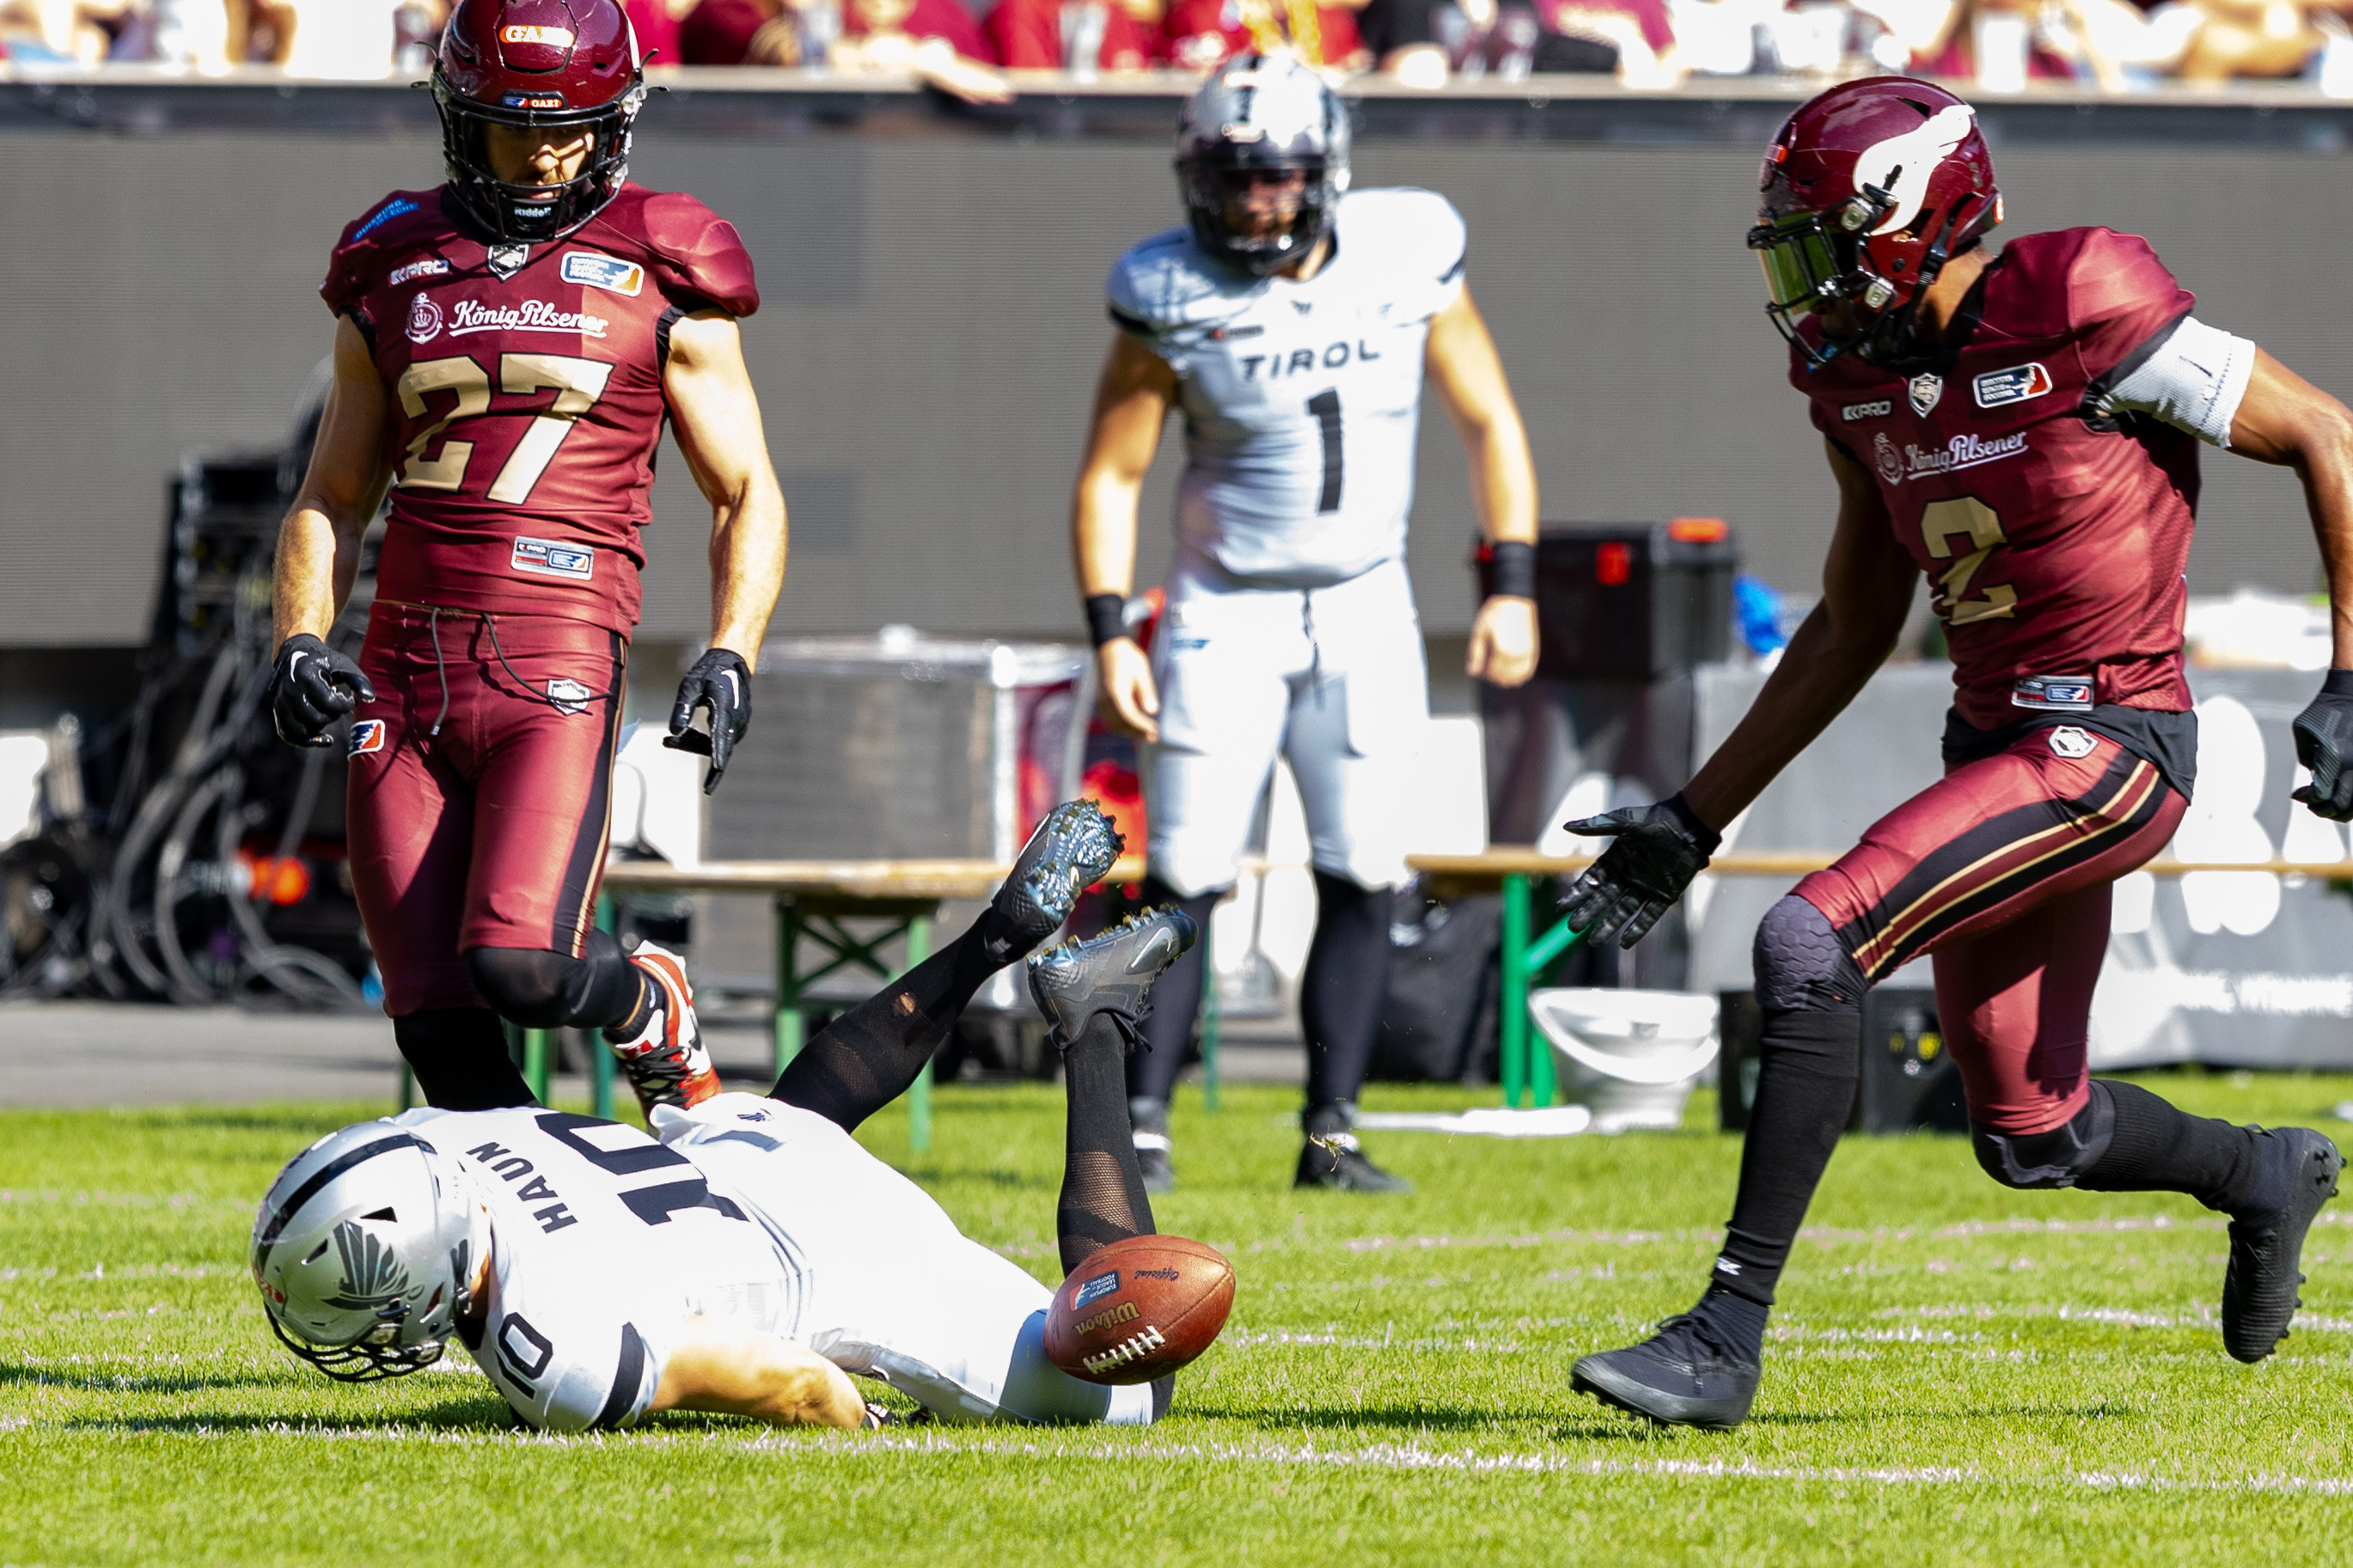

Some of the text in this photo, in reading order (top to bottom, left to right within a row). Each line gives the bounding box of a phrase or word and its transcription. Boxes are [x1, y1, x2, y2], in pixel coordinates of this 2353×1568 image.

[505, 25, 571, 47] GA
[449, 300, 608, 333] König Pilsener
[1242, 340, 1381, 381] TIROL
[397, 352, 616, 506] 27
[1307, 385, 1344, 516] 1
[1948, 431, 2027, 466] Pilsener
[1921, 495, 2018, 625] 2
[534, 1112, 750, 1227] 10
[466, 1142, 579, 1235] HAUN
[1089, 1283, 1116, 1299] EUROPEAN
[1090, 1273, 1115, 1287] FOOTBALL
[1097, 1278, 1115, 1290] LEAGUE
[1134, 1266, 1180, 1283] Official
[1073, 1300, 1142, 1336] Wilson
[495, 1312, 554, 1400] 10
